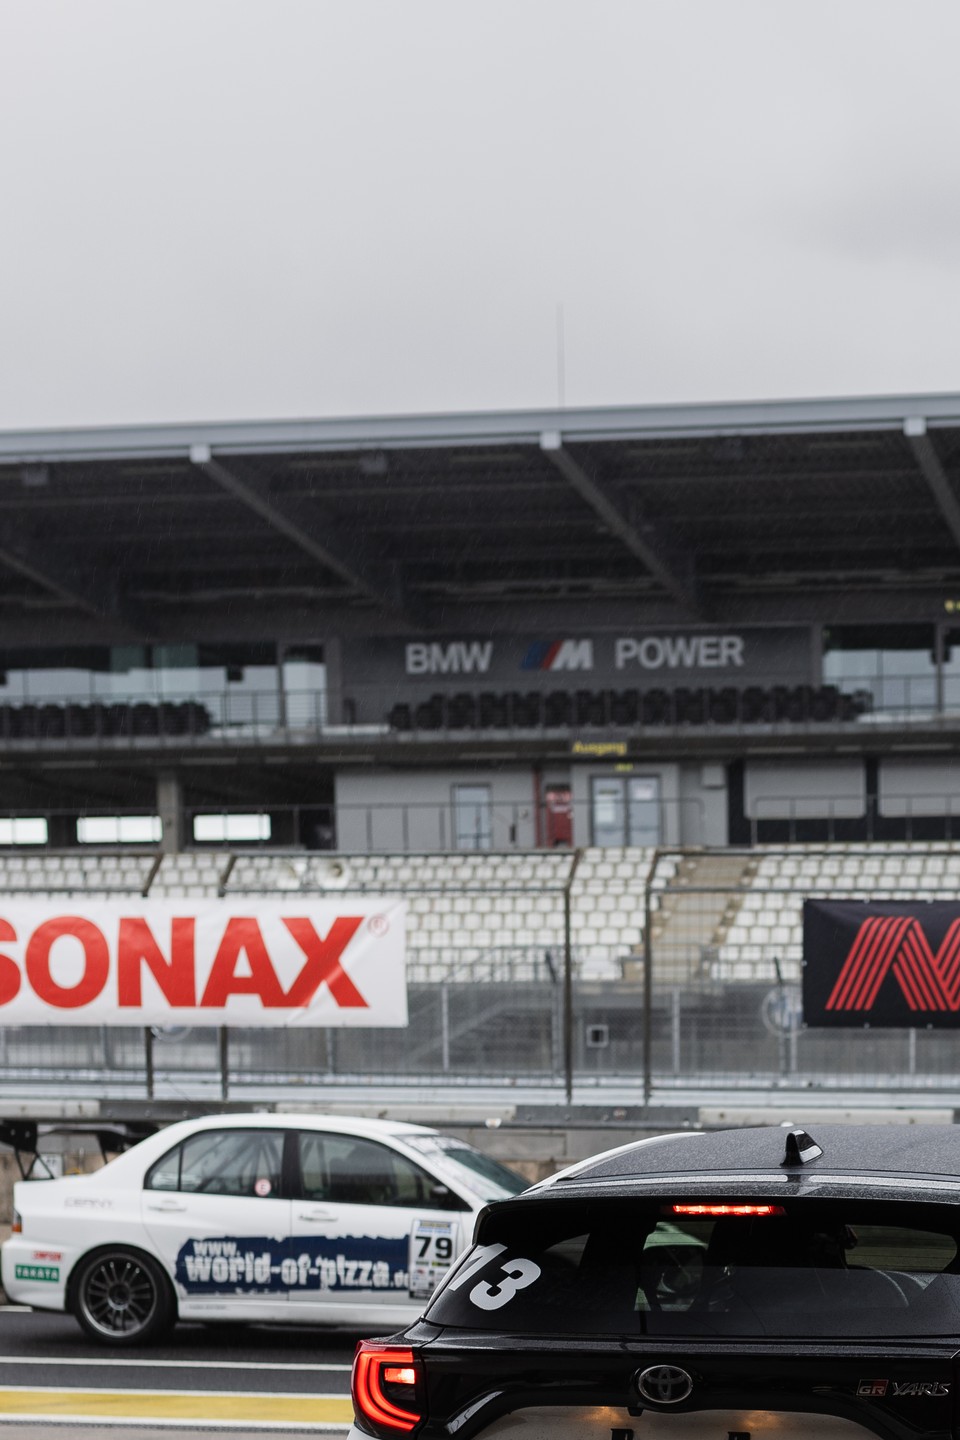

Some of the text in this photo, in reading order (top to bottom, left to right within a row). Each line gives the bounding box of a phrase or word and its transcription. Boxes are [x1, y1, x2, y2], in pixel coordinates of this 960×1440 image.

[405, 642, 493, 674] BMW
[615, 636, 745, 670] POWER
[193, 1241, 241, 1257] www.
[415, 1236, 453, 1260] 79
[15, 1266, 60, 1281] TAKATA
[448, 1243, 541, 1311] 13
[858, 1385, 884, 1395] GR
